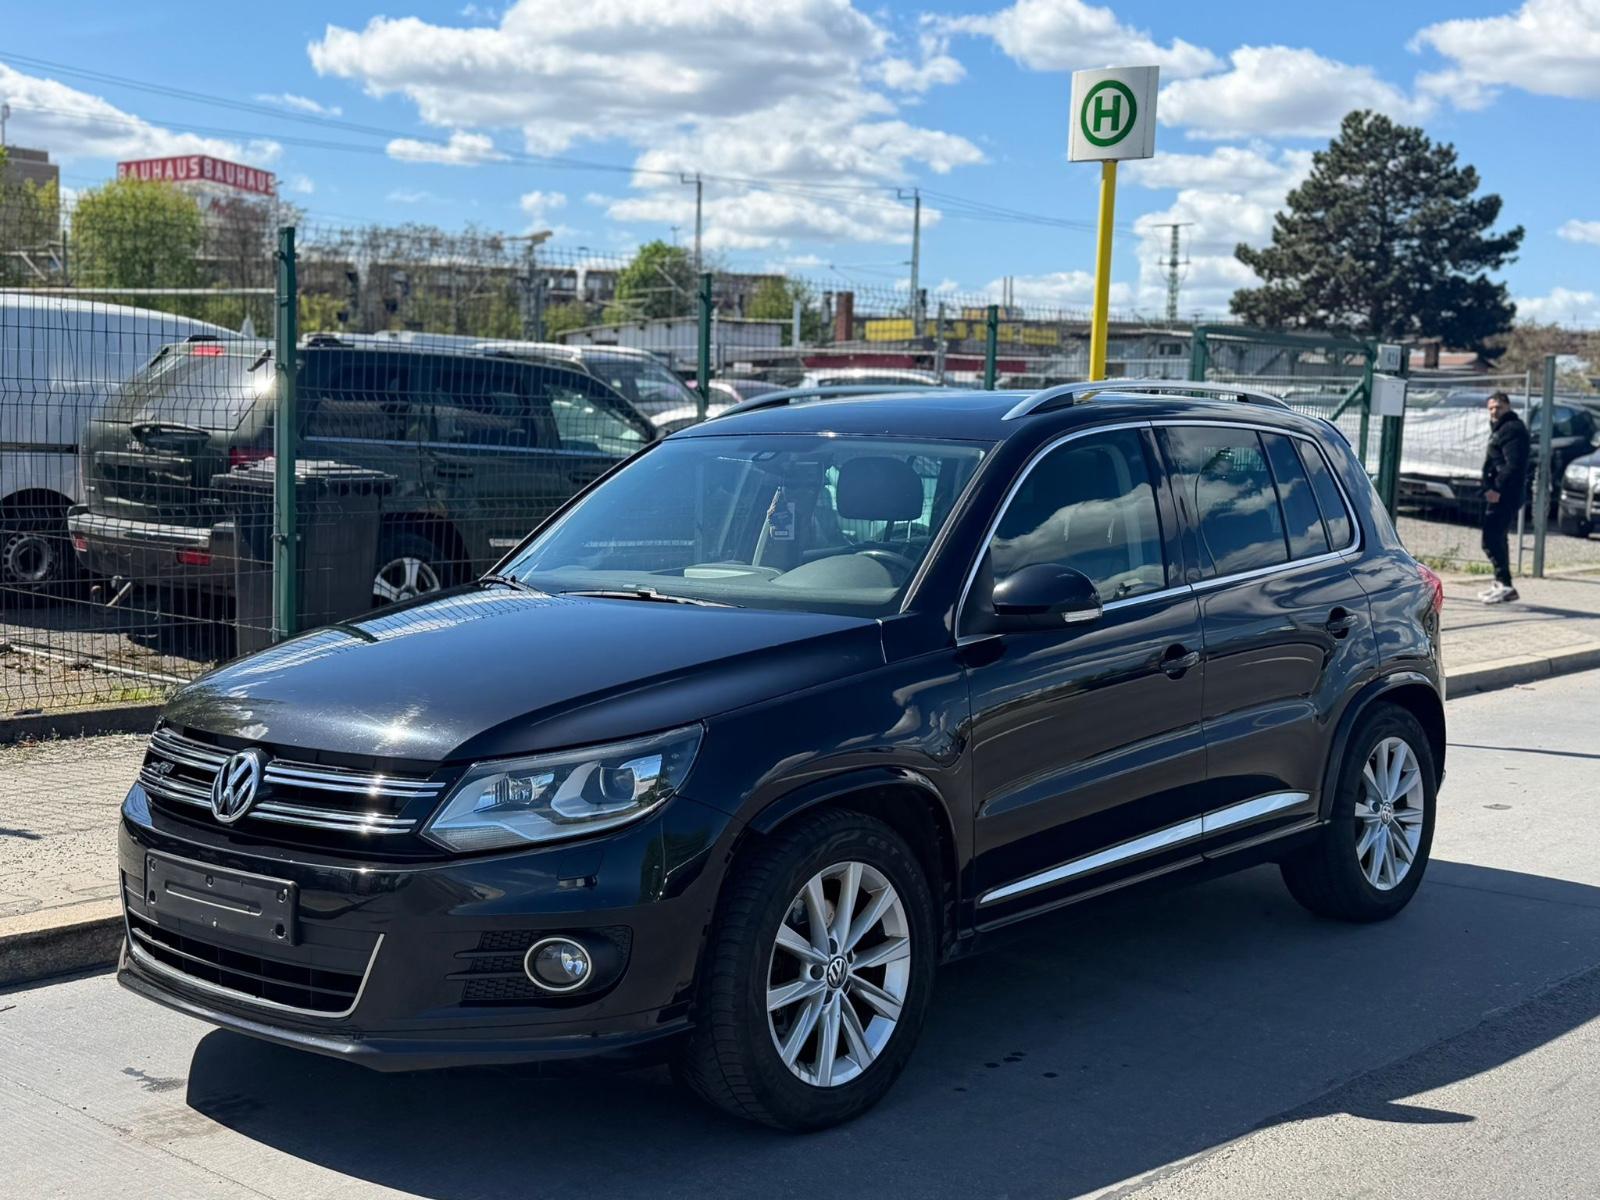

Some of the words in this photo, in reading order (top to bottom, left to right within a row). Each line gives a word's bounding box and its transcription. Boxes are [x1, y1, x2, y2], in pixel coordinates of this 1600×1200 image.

[1093, 94, 1121, 132] H
[118, 157, 200, 182] BAUHAUS
[203, 156, 275, 194] BAUHAUS
